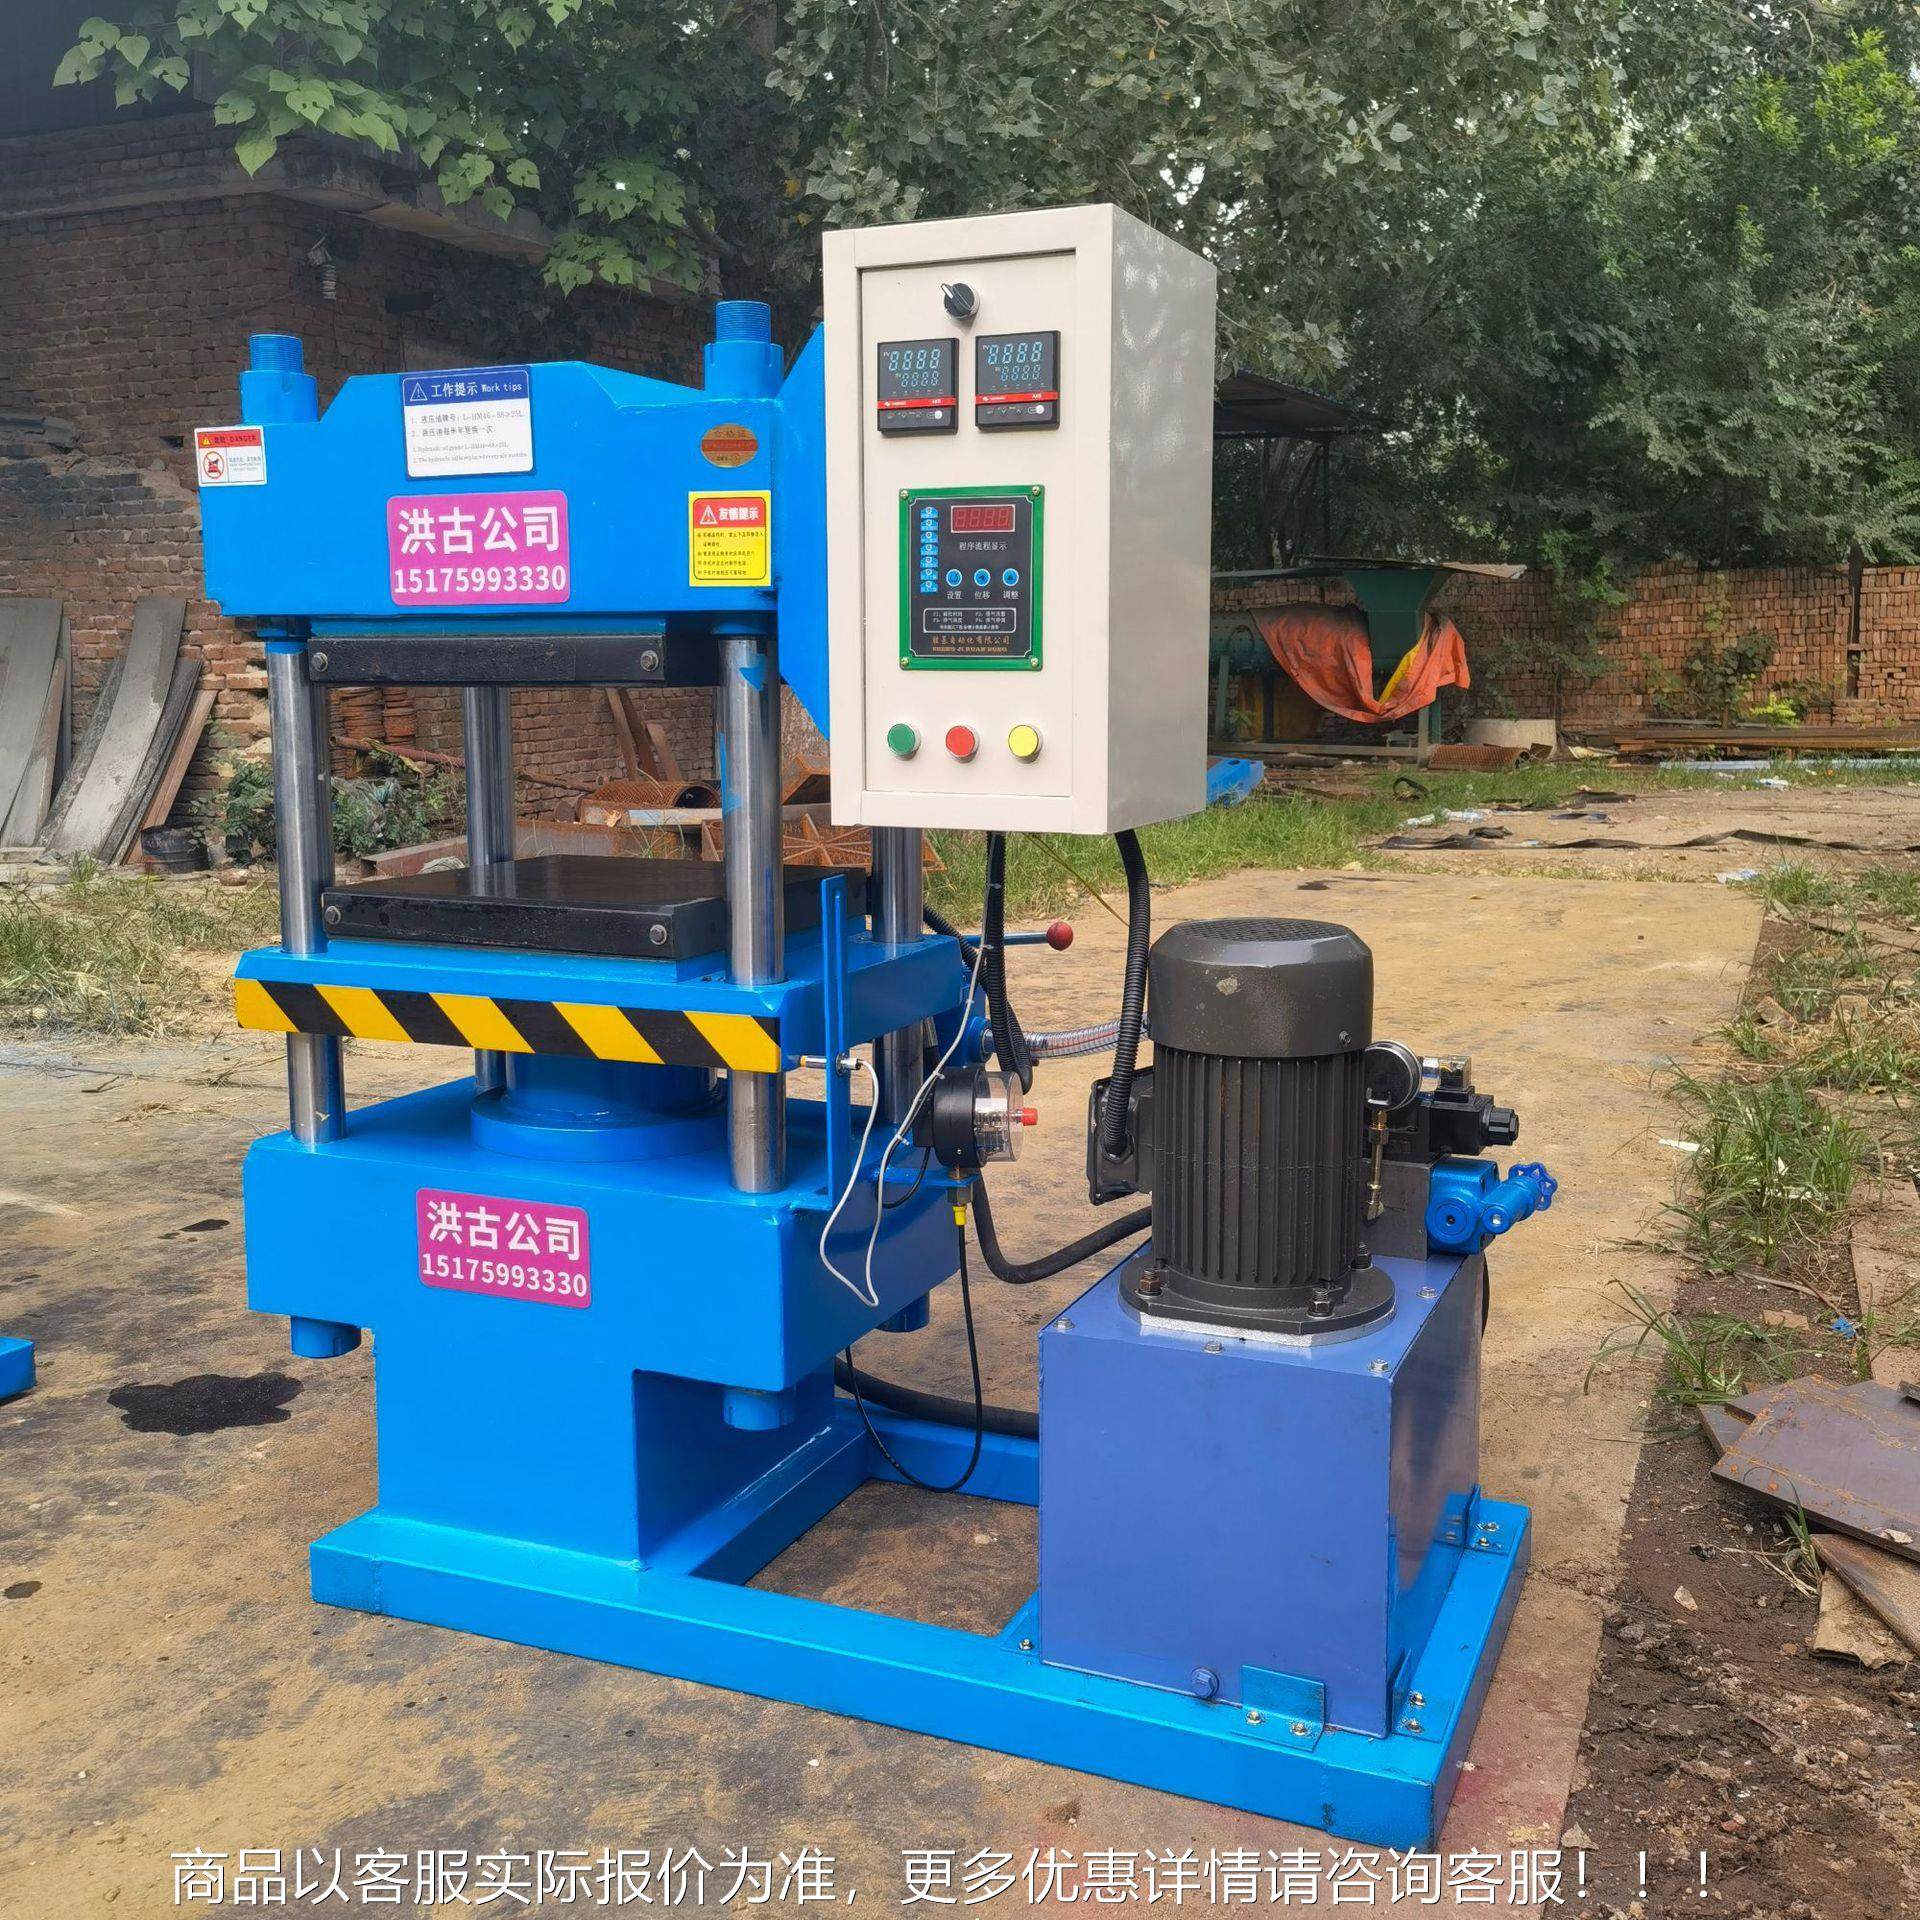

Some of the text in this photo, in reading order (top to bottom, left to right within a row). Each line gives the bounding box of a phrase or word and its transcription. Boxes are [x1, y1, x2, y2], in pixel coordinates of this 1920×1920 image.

[431, 382, 522, 398] 工作提示 Work tips
[398, 506, 559, 554] 洪古公司
[959, 541, 1008, 551] 程序流程显示
[394, 565, 566, 593] 15175993330
[947, 590, 1019, 600] 设置 位移 调整
[427, 1200, 580, 1261] 洪古公司
[422, 1253, 588, 1297] 15175993330
